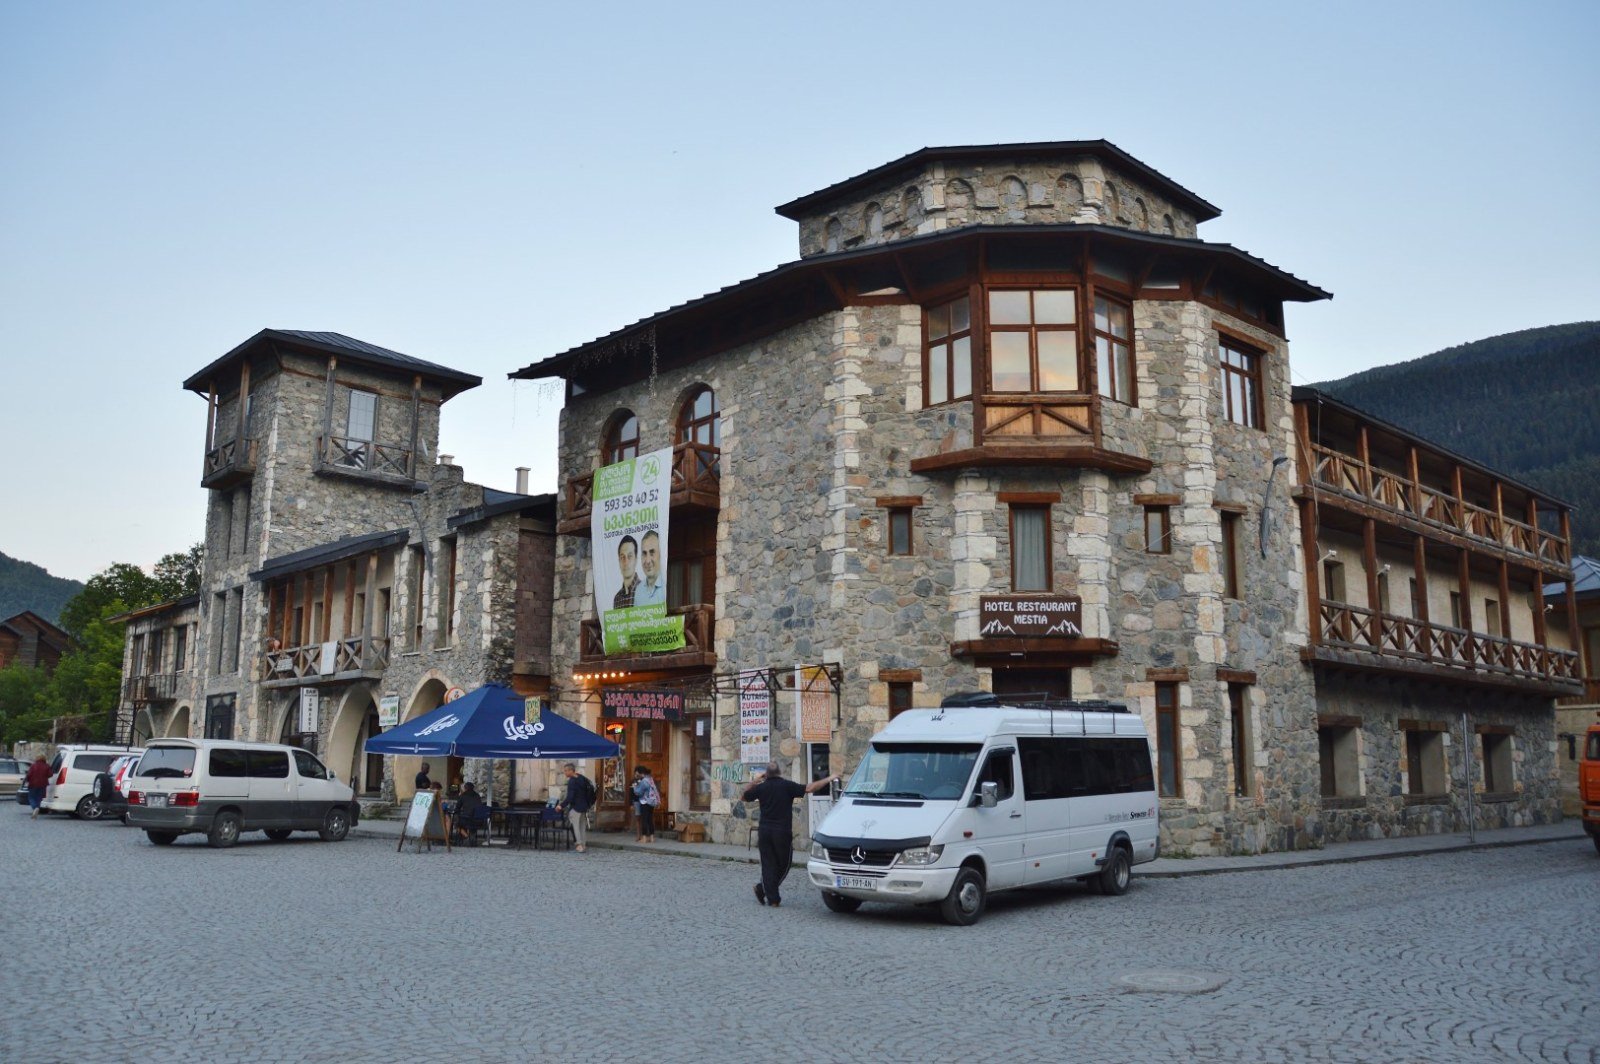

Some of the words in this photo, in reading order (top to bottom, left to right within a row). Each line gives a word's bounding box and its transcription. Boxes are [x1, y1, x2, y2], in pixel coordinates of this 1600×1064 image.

[642, 461, 658, 478] 24
[604, 498, 620, 512] 593
[621, 495, 633, 509] 58
[635, 491, 647, 505] 40
[604, 505, 659, 531] სვანეთი
[984, 601, 1015, 612] HOTEL
[1017, 601, 1077, 612] RESTAURANT
[1013, 614, 1048, 625] MESTIA
[742, 701, 769, 709] ZUGDIDI
[616, 706, 630, 718] BUS
[742, 709, 768, 718] BATUMI
[742, 718, 768, 726] USHGULI
[503, 715, 545, 741] Argo
